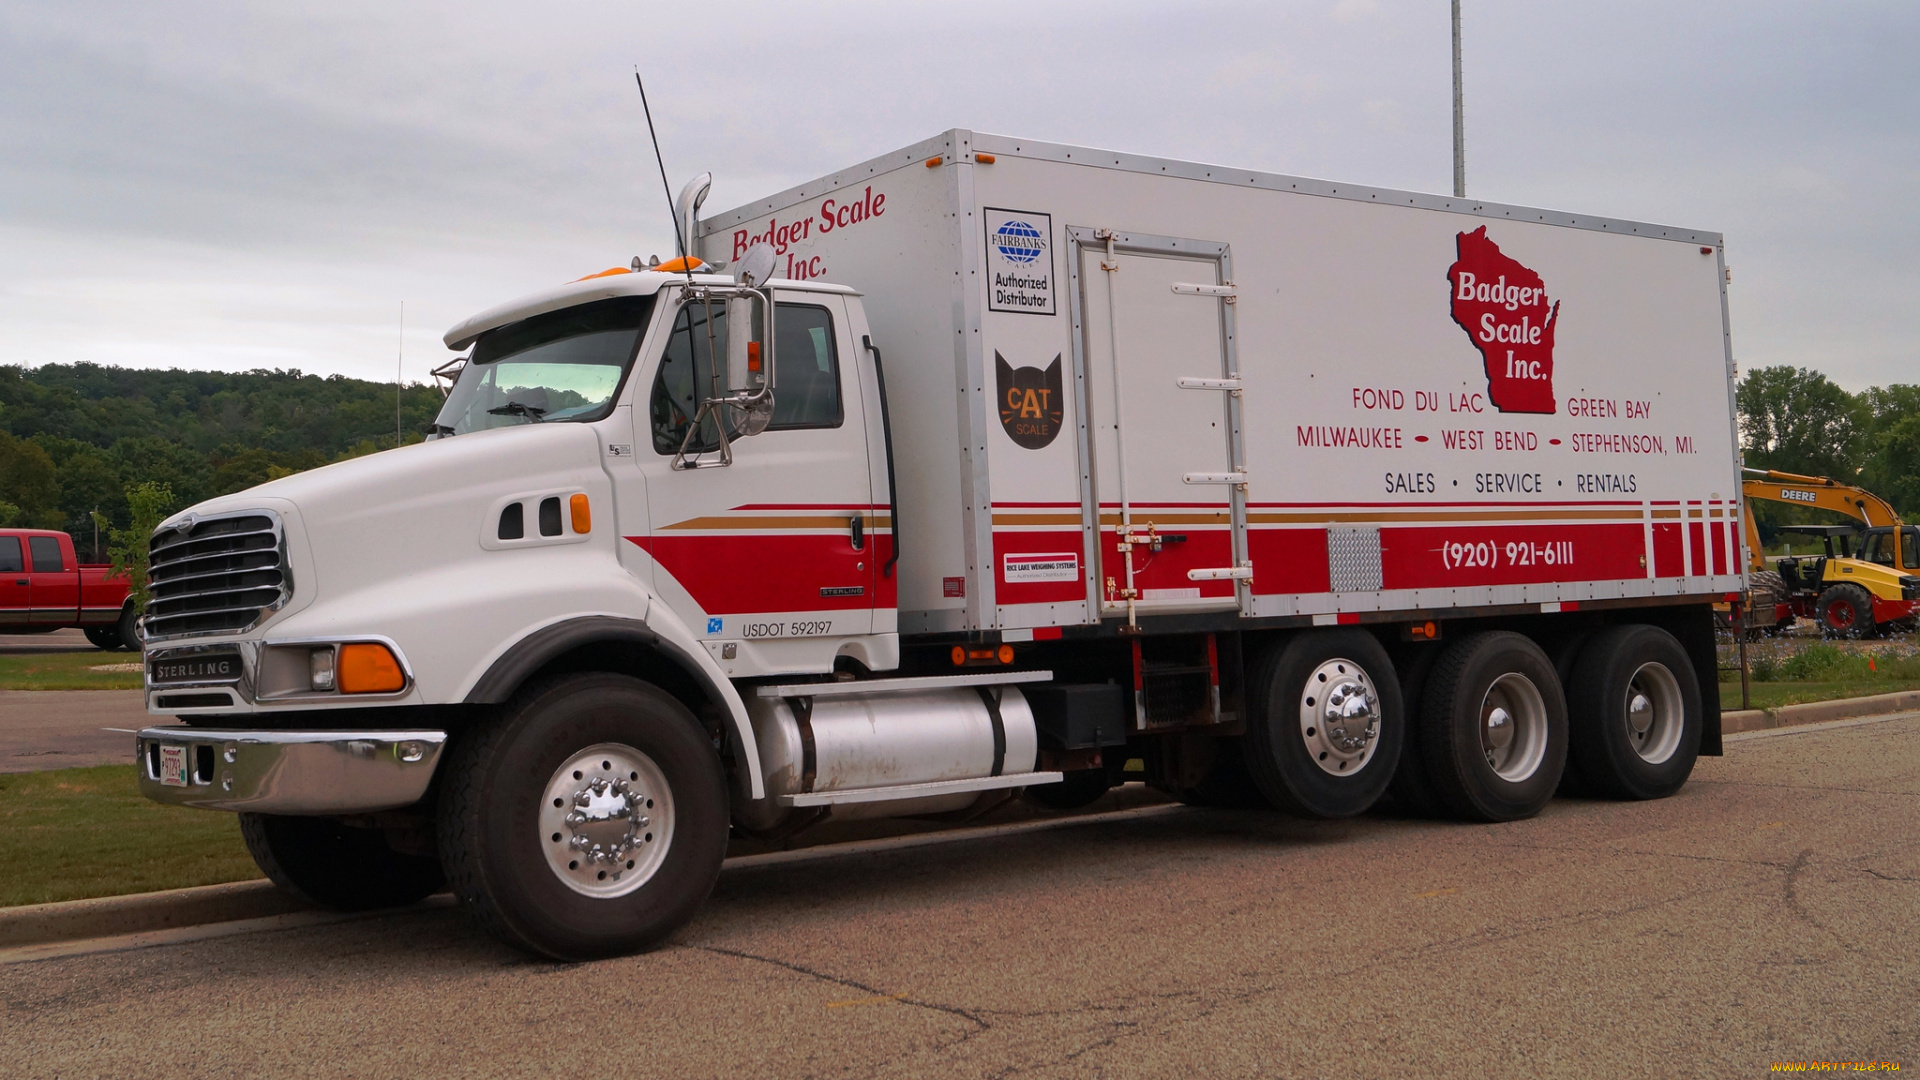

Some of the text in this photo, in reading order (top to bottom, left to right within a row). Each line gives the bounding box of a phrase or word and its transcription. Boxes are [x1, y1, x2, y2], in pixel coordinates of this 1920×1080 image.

[818, 185, 886, 234] Scale
[991, 233, 1047, 250] FAIRBANKS
[786, 252, 827, 281] Inc.
[1001, 255, 1040, 270] SCALES
[995, 272, 1048, 290] Authorized
[1456, 271, 1544, 312] Badger
[996, 289, 1047, 308] Distributor
[1478, 312, 1542, 346] Scale
[1505, 349, 1548, 381] Inc.
[1007, 387, 1052, 419] CAT
[1352, 387, 1484, 413] FOND DU LAC
[1567, 397, 1651, 419] GREEN BAY
[1015, 423, 1049, 436] SCALE
[1296, 425, 1698, 457] MILWAUKEE WEST BEND STEPHENSON, MI.
[1384, 472, 1638, 494] SALES SERVICE RENTALS
[1781, 489, 1817, 503] DEERE
[1442, 539, 1574, 571] (920) 921-6111
[1006, 561, 1077, 572] RICE LAKE WEIGHING SYSTEMS
[742, 620, 833, 637] USDOT 592197
[158, 661, 230, 678] STERLING
